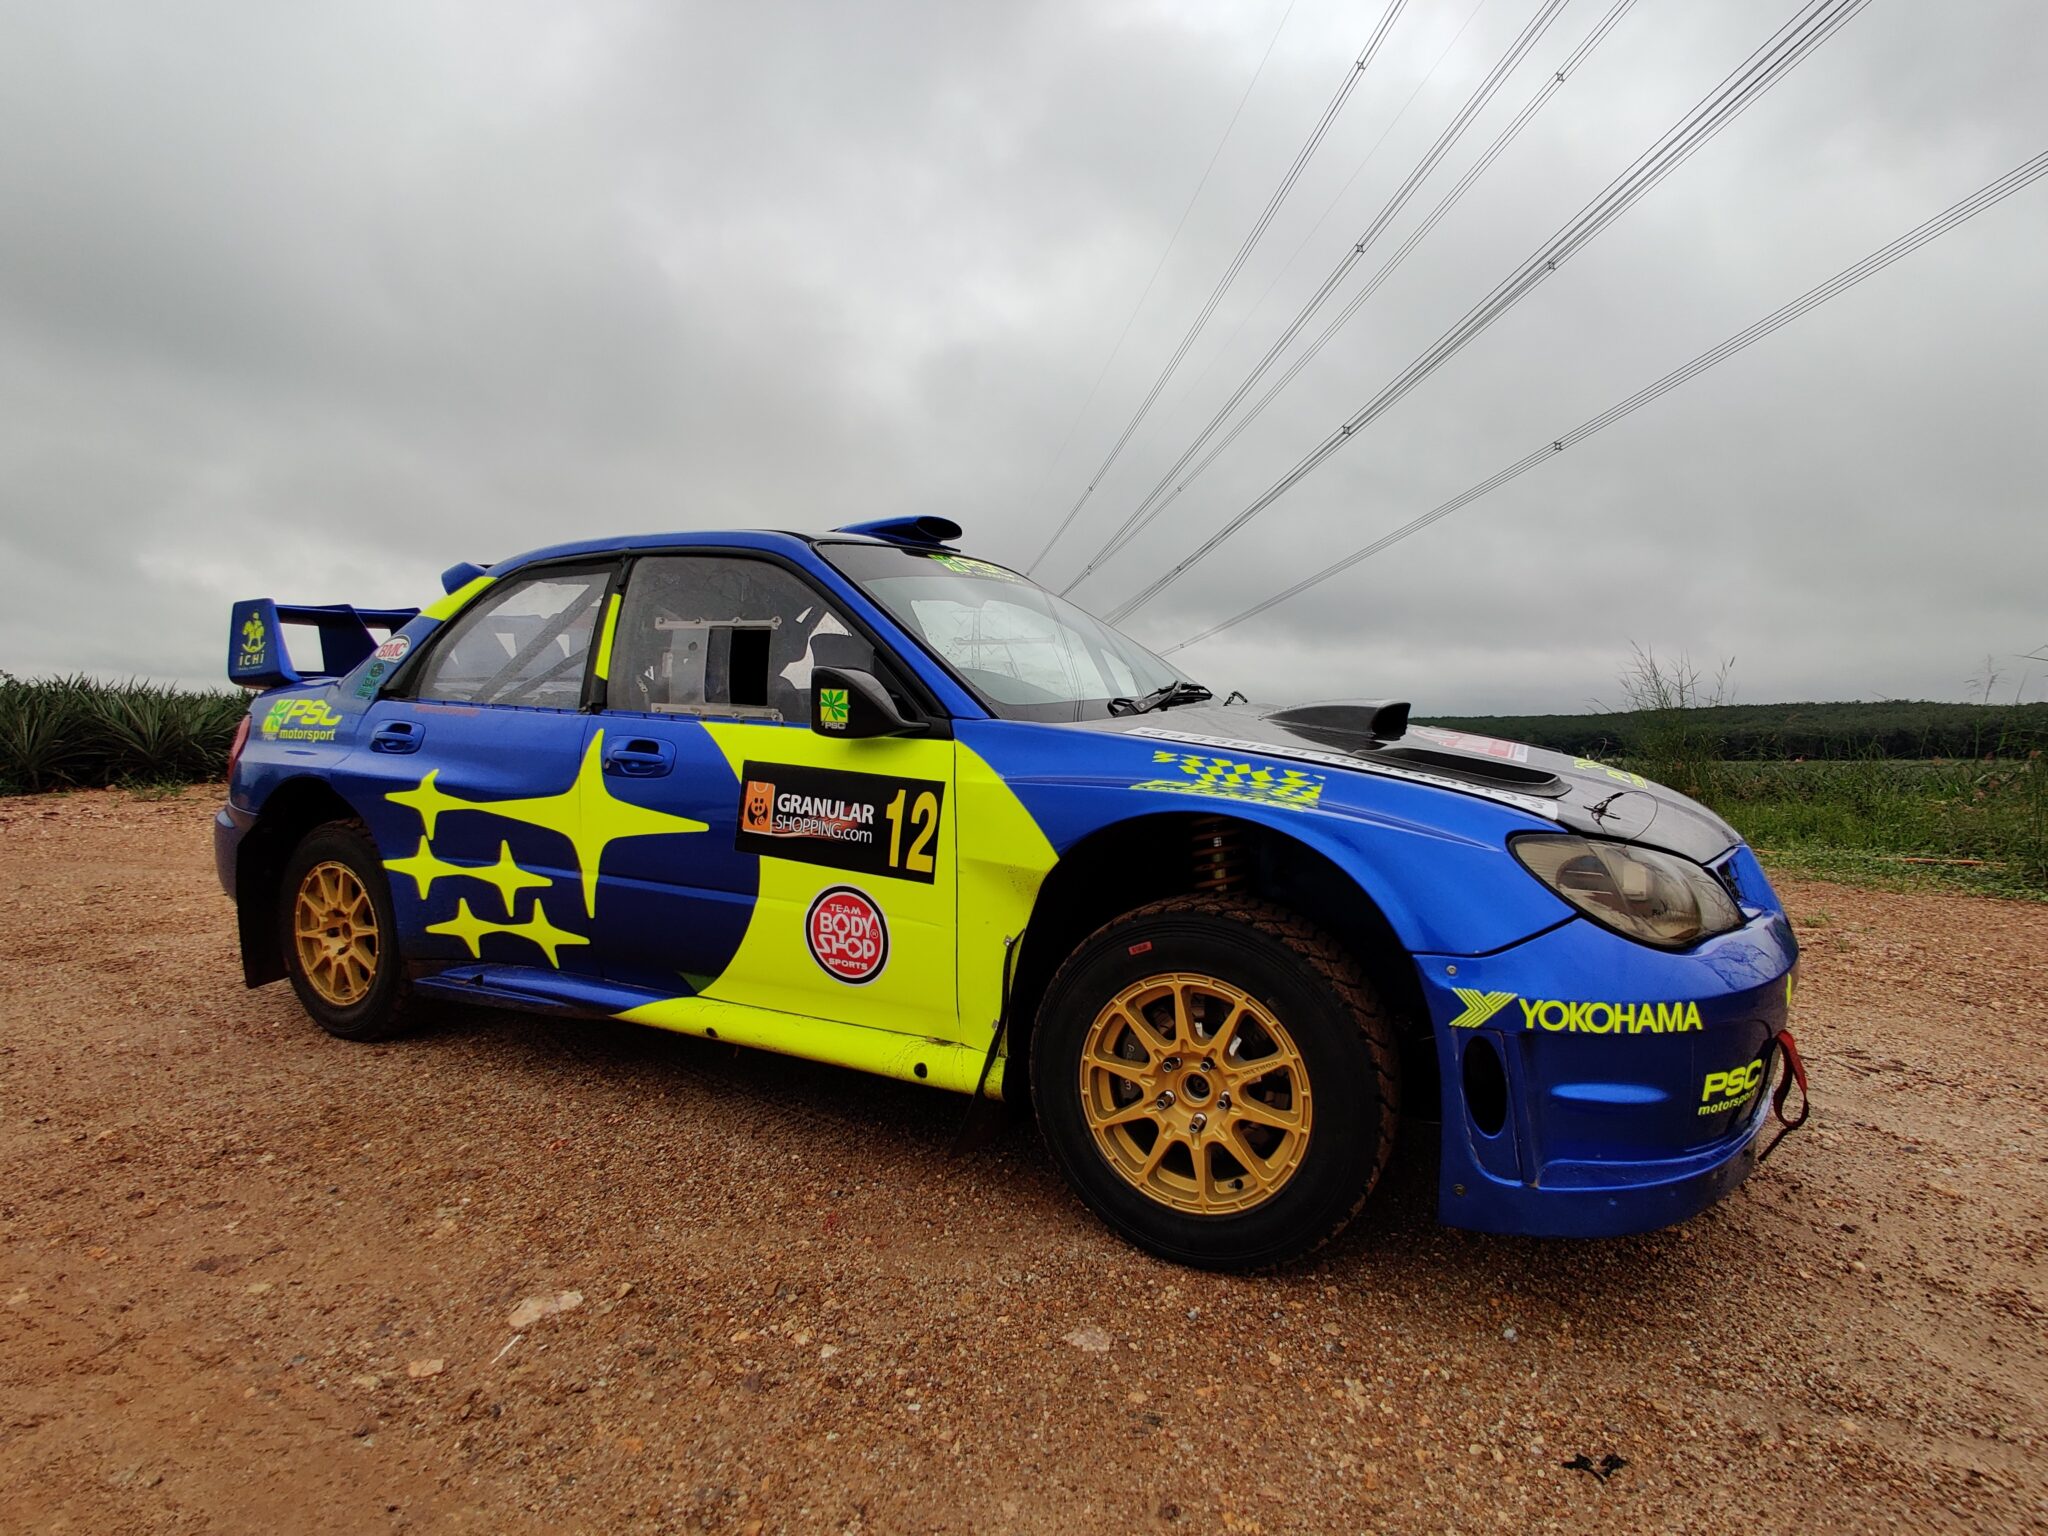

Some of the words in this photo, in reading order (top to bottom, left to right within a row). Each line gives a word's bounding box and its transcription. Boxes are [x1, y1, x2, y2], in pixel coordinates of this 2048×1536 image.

[280, 728, 336, 743] motorsport
[824, 721, 846, 730] PSC
[777, 793, 875, 825] GRANULAR
[775, 814, 873, 844] SHOPPING.com
[886, 789, 938, 873] 12
[829, 903, 862, 916] TEAM
[820, 911, 876, 940] BODY
[815, 933, 877, 960] SHOP
[828, 957, 869, 971] SPORTS
[1519, 998, 1703, 1034] YOKOHAMA
[1702, 1058, 1763, 1103] PSC
[1697, 1086, 1759, 1117] motorsport
